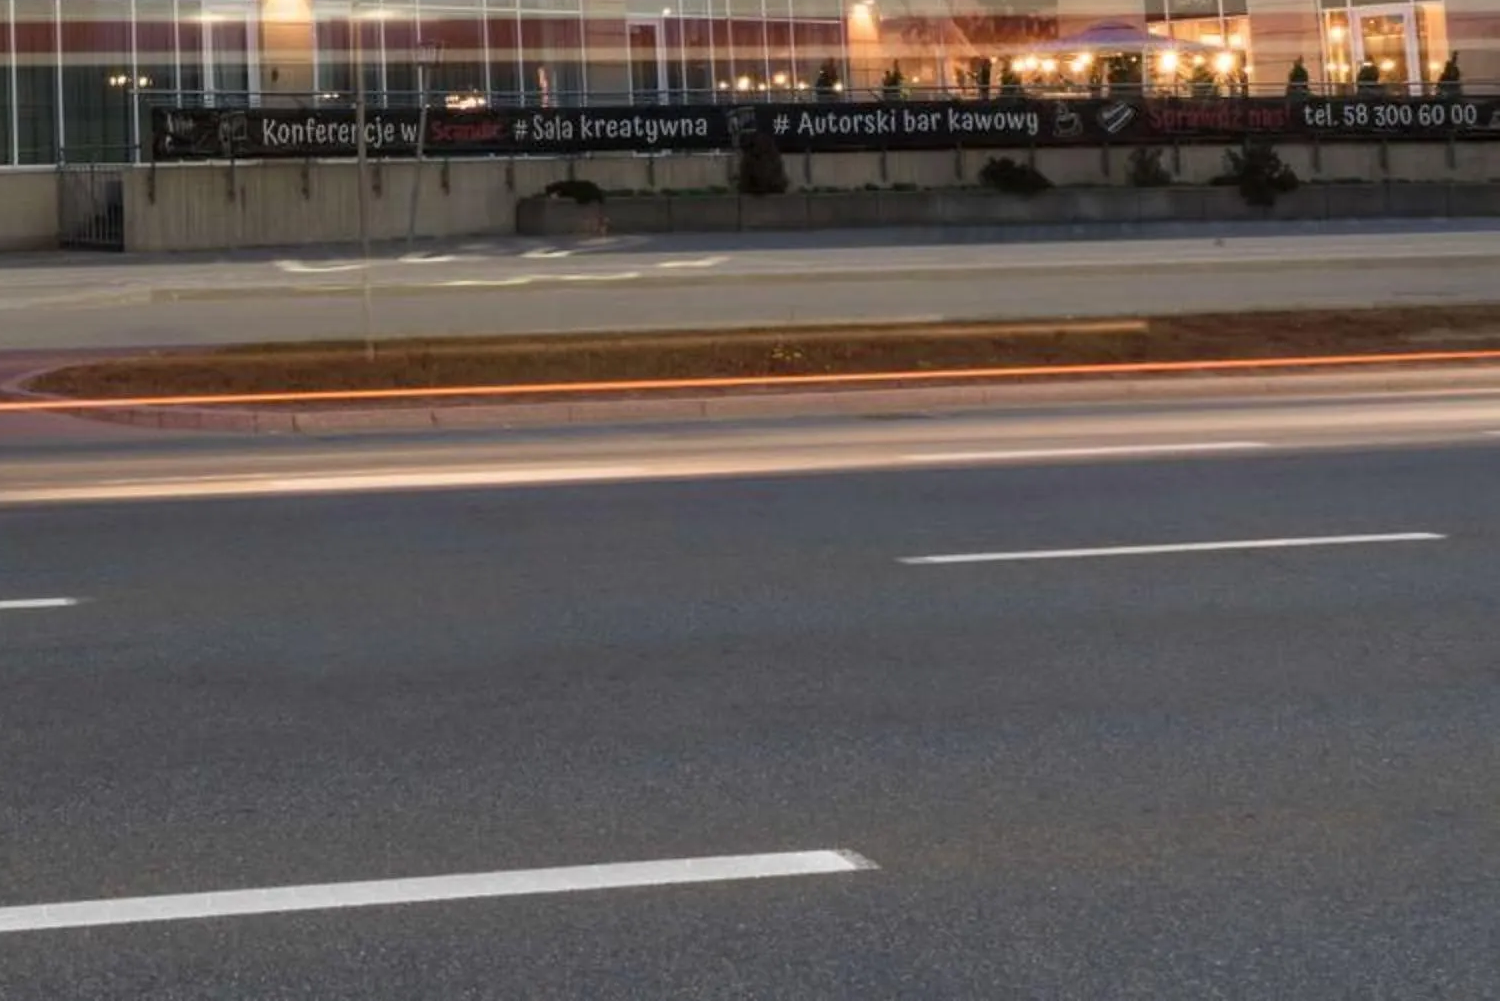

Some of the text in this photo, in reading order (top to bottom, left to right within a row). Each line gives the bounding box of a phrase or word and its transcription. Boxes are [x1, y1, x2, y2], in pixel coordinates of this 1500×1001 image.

[401, 122, 417, 142] w
[580, 114, 708, 143] kreatywna
[797, 108, 897, 136] Autorski
[903, 108, 941, 132] bar
[949, 106, 1039, 136] kawowy
[1303, 102, 1478, 126] tel. 58 300 60 00
